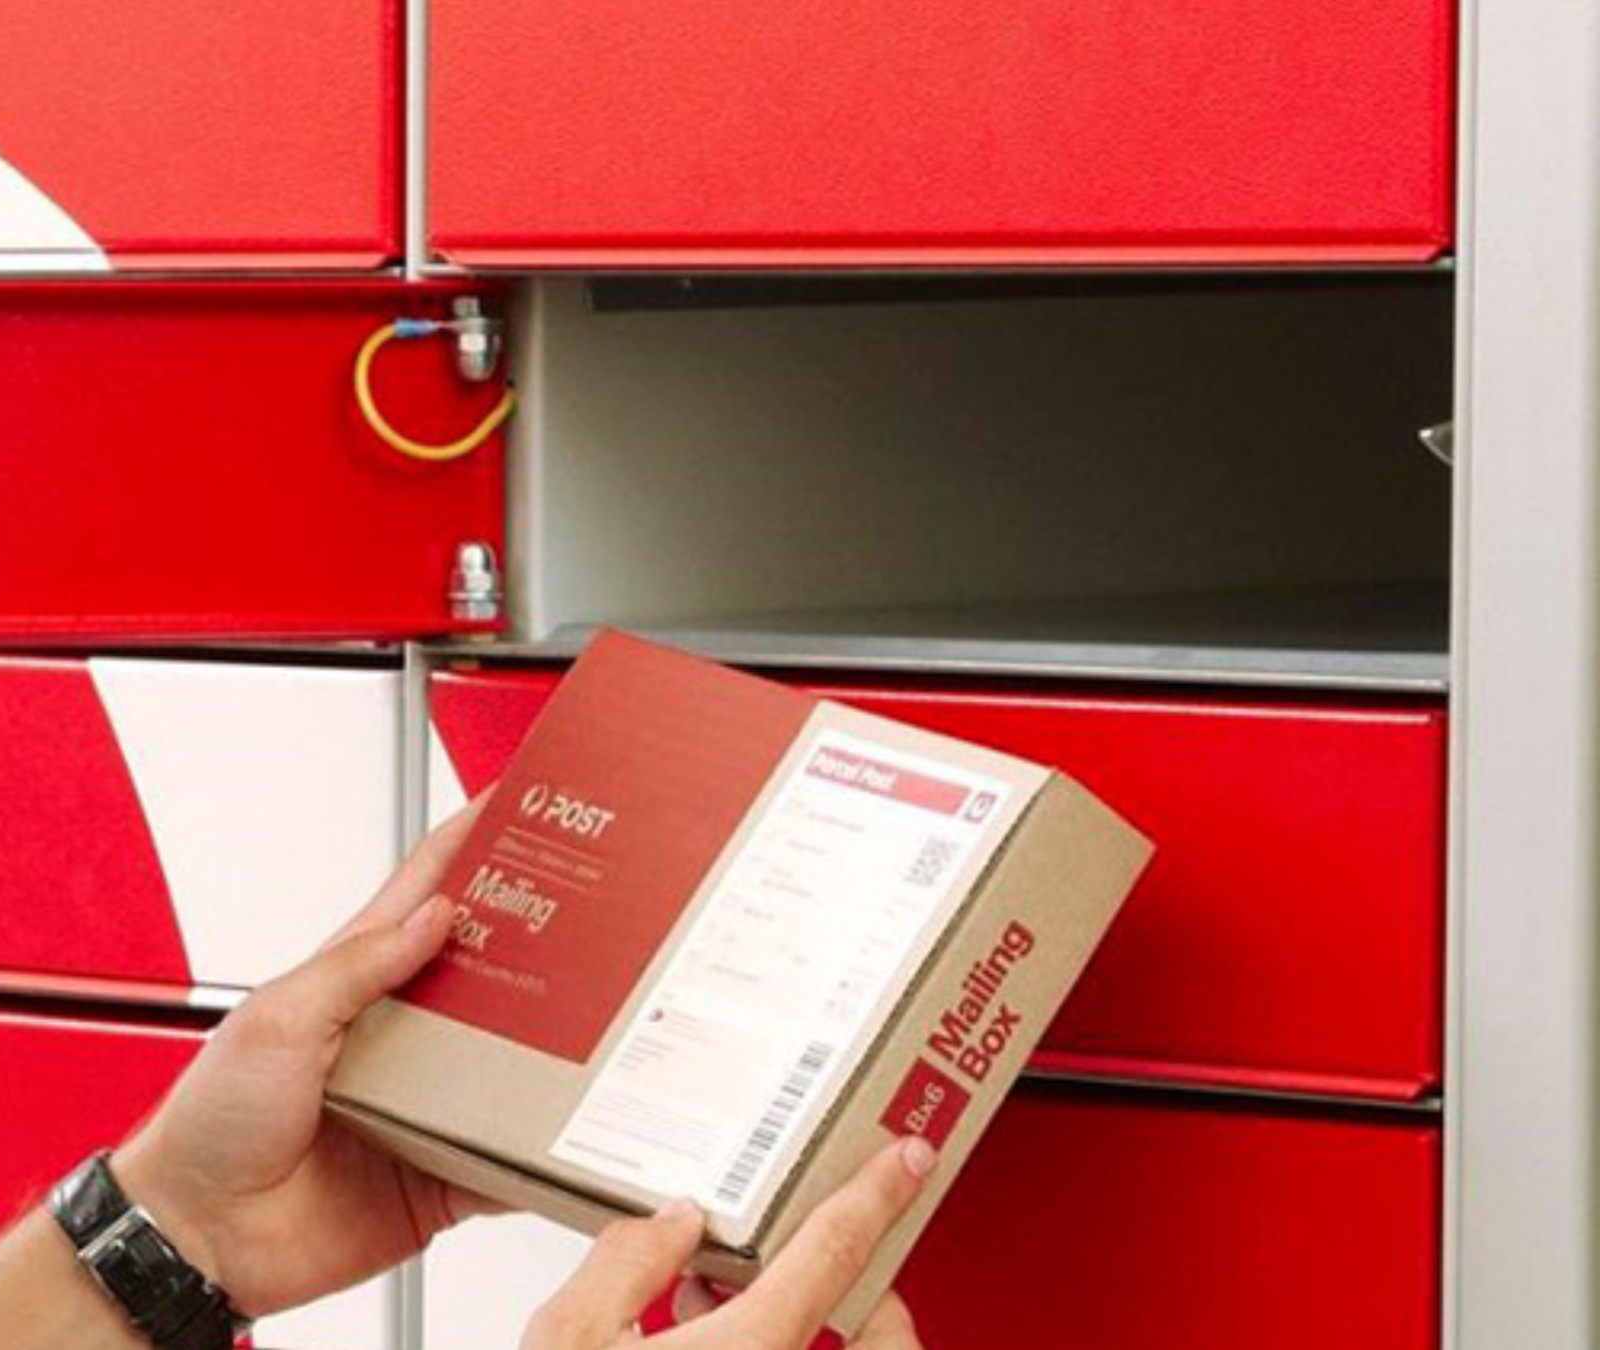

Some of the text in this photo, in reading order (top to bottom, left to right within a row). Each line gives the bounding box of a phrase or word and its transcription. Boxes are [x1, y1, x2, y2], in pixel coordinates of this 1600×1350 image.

[542, 794, 615, 838] POST
[463, 865, 557, 933] Mailing
[927, 919, 1035, 1061] Mailing
[957, 1003, 1021, 1083] Box
